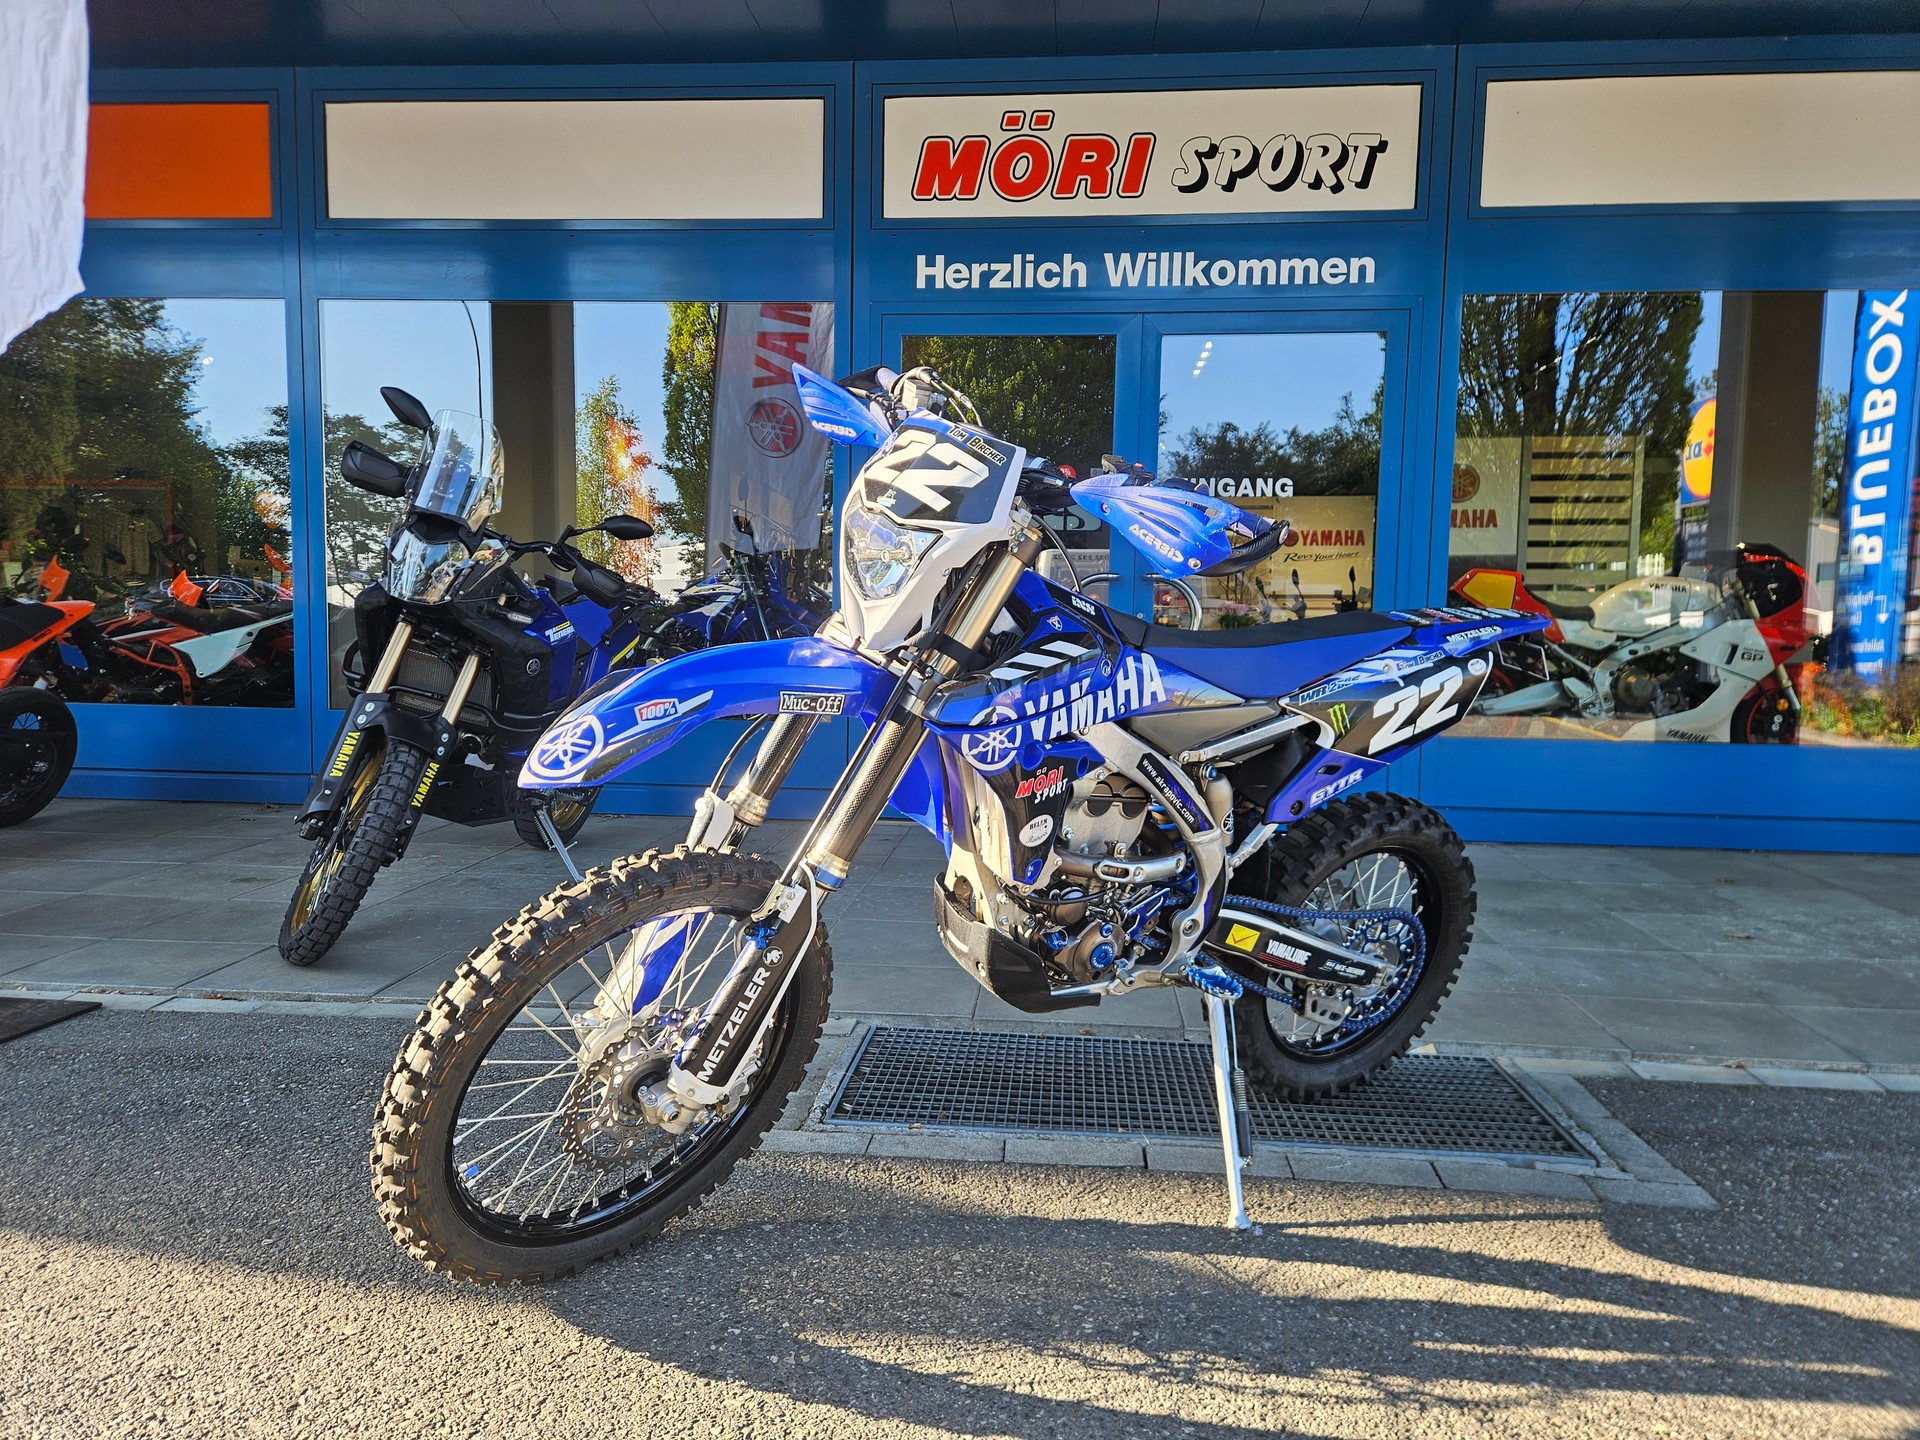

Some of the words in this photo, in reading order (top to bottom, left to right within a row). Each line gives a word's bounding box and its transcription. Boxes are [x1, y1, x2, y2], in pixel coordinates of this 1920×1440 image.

[912, 110, 1157, 202] MÖRI
[1171, 132, 1389, 194] SPORT
[916, 254, 1087, 289] Herzlich
[1104, 251, 1376, 288] Willkommen
[864, 429, 990, 512] 22
[1183, 477, 1294, 498] NGANG
[1300, 529, 1366, 546] YAMAHA
[1283, 552, 1313, 563] Revs
[1313, 552, 1334, 563] Your
[1335, 551, 1360, 559] Heart
[1446, 626, 1495, 643] METZELER
[639, 701, 676, 723] 100%
[783, 694, 843, 713] Muc-Off
[1024, 652, 1167, 742] YAMAHA
[1367, 665, 1463, 755] 22
[329, 730, 361, 777] YAMAHA
[411, 761, 440, 807] YAMAHA
[1015, 765, 1064, 798] MÖRI
[1034, 777, 1068, 804] SPORT
[1310, 768, 1363, 807] GYTR
[697, 966, 772, 1083] METZELER
